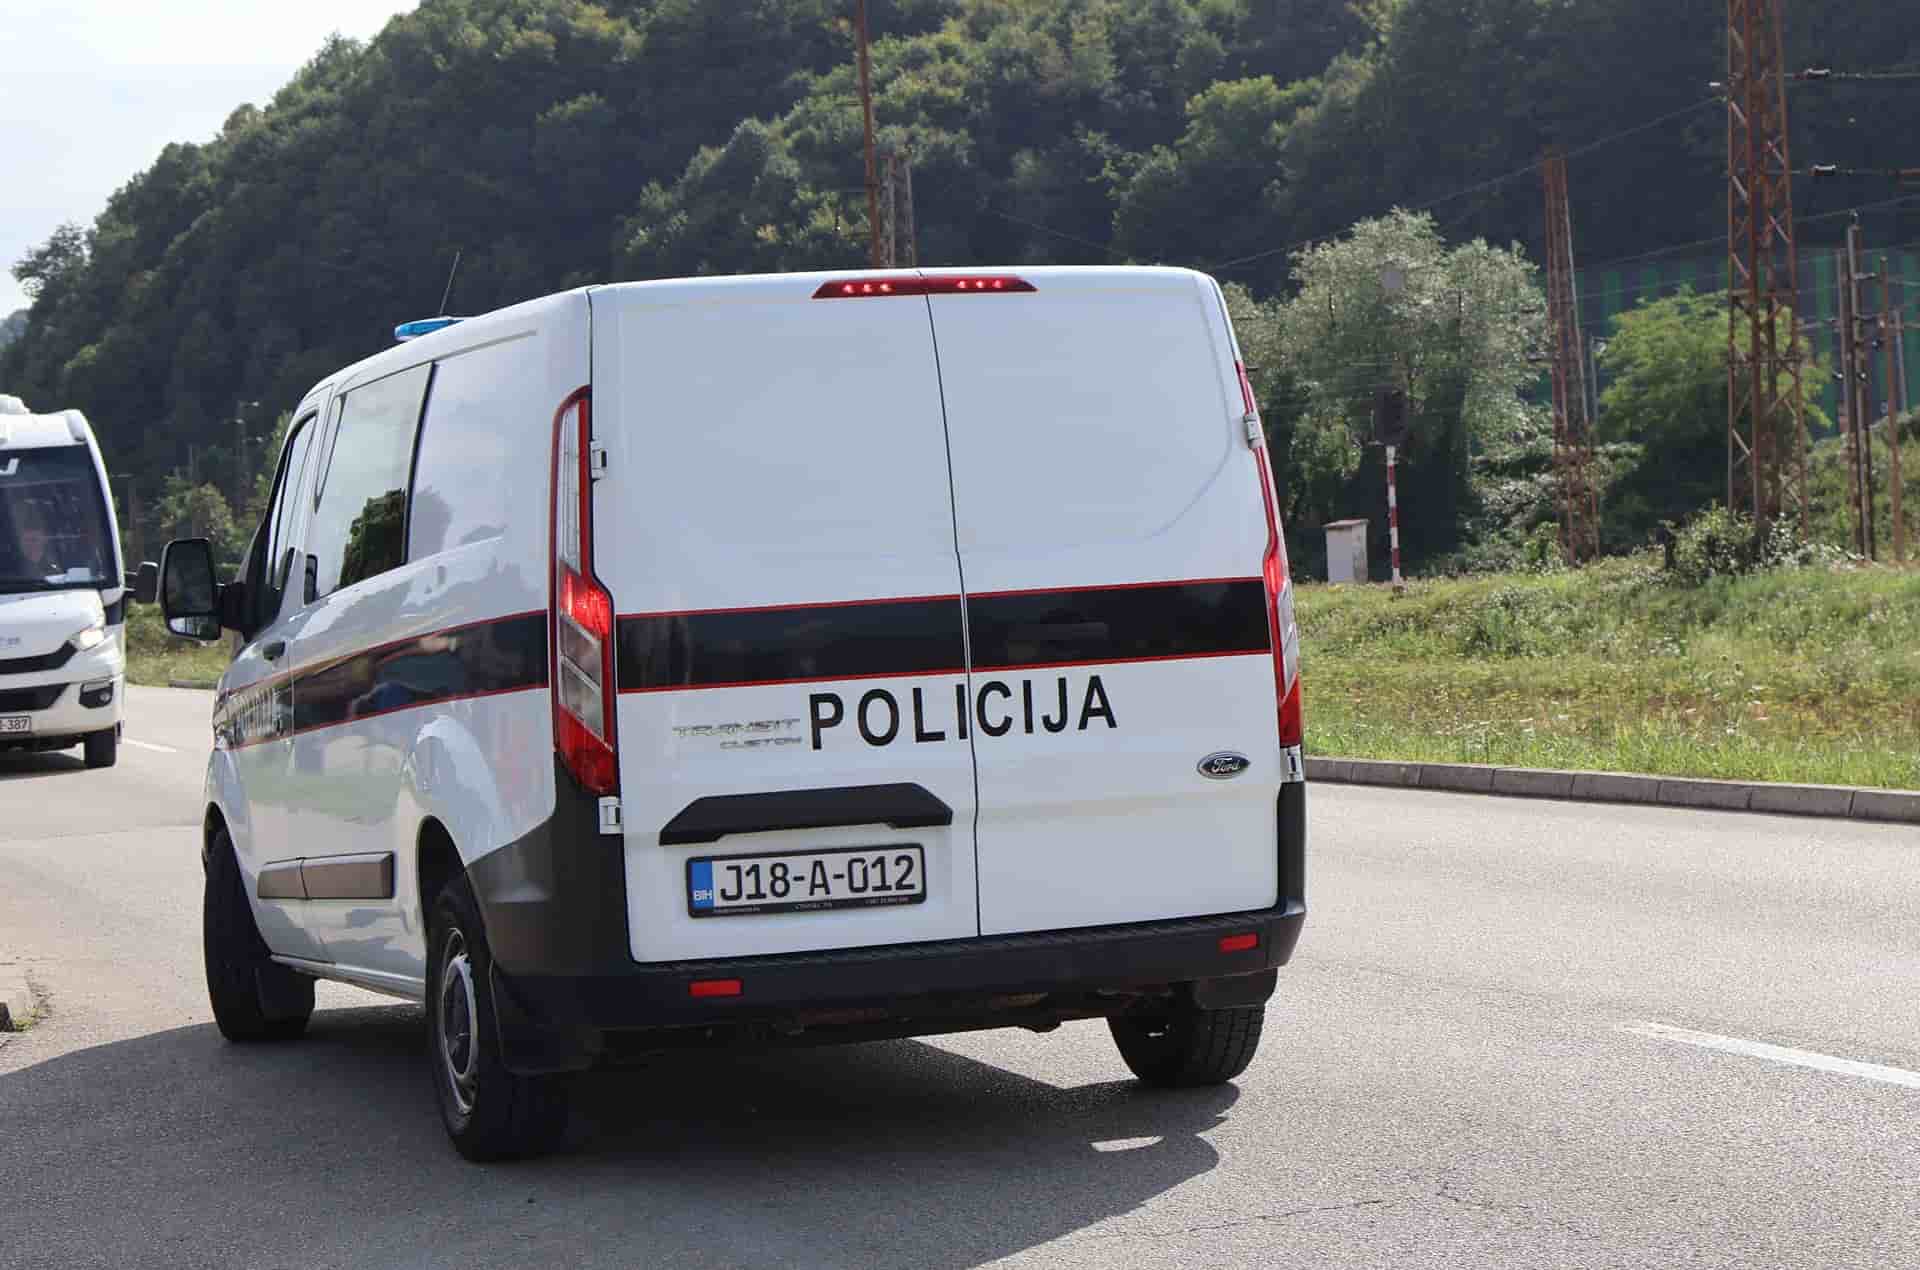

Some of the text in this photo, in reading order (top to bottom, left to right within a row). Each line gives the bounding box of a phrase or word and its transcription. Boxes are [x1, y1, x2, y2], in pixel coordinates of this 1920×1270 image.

[809, 675, 1118, 750] POLICIJA
[1211, 757, 1241, 773] Ford
[720, 855, 916, 901] J18-A-012
[694, 888, 713, 902] BIH
